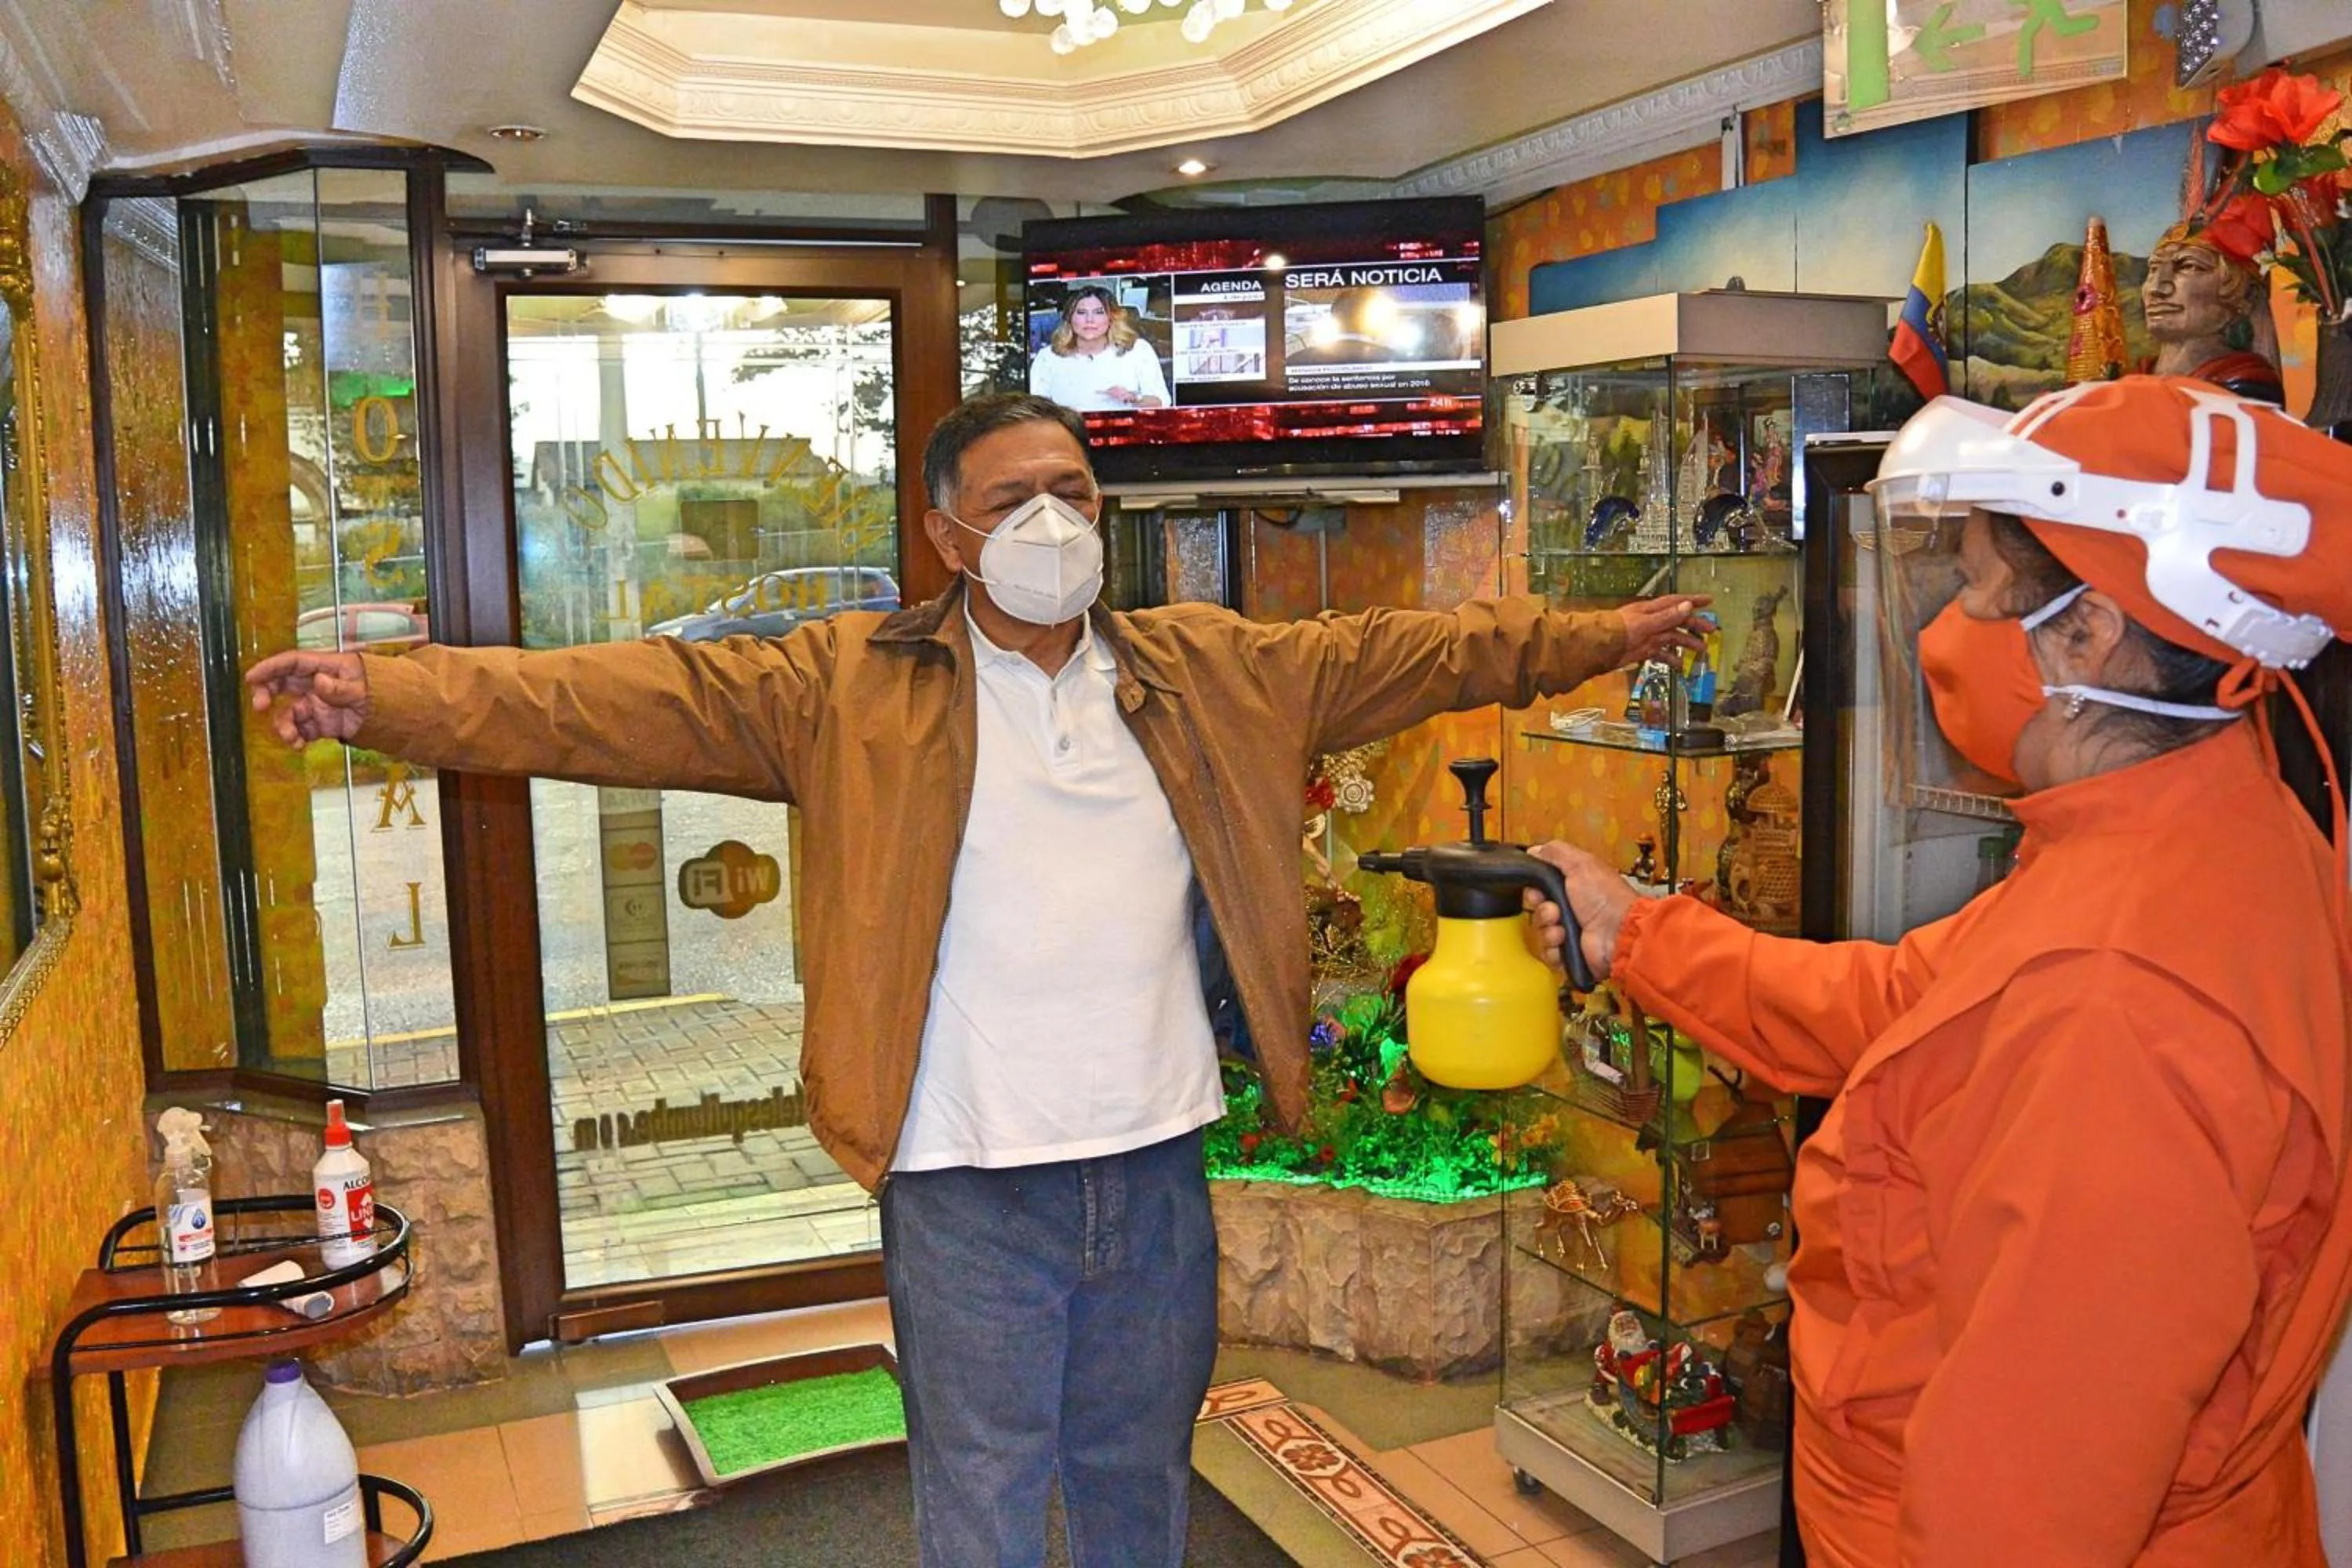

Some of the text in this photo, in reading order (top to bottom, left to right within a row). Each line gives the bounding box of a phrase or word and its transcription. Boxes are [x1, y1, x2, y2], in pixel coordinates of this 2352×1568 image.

[1284, 267, 1443, 289] SERÁ NOTICIA
[1200, 280, 1261, 292] AGENDA
[1382, 374, 1396, 383] por
[1343, 382, 1368, 390] abuso
[343, 1176, 368, 1191] ALCO
